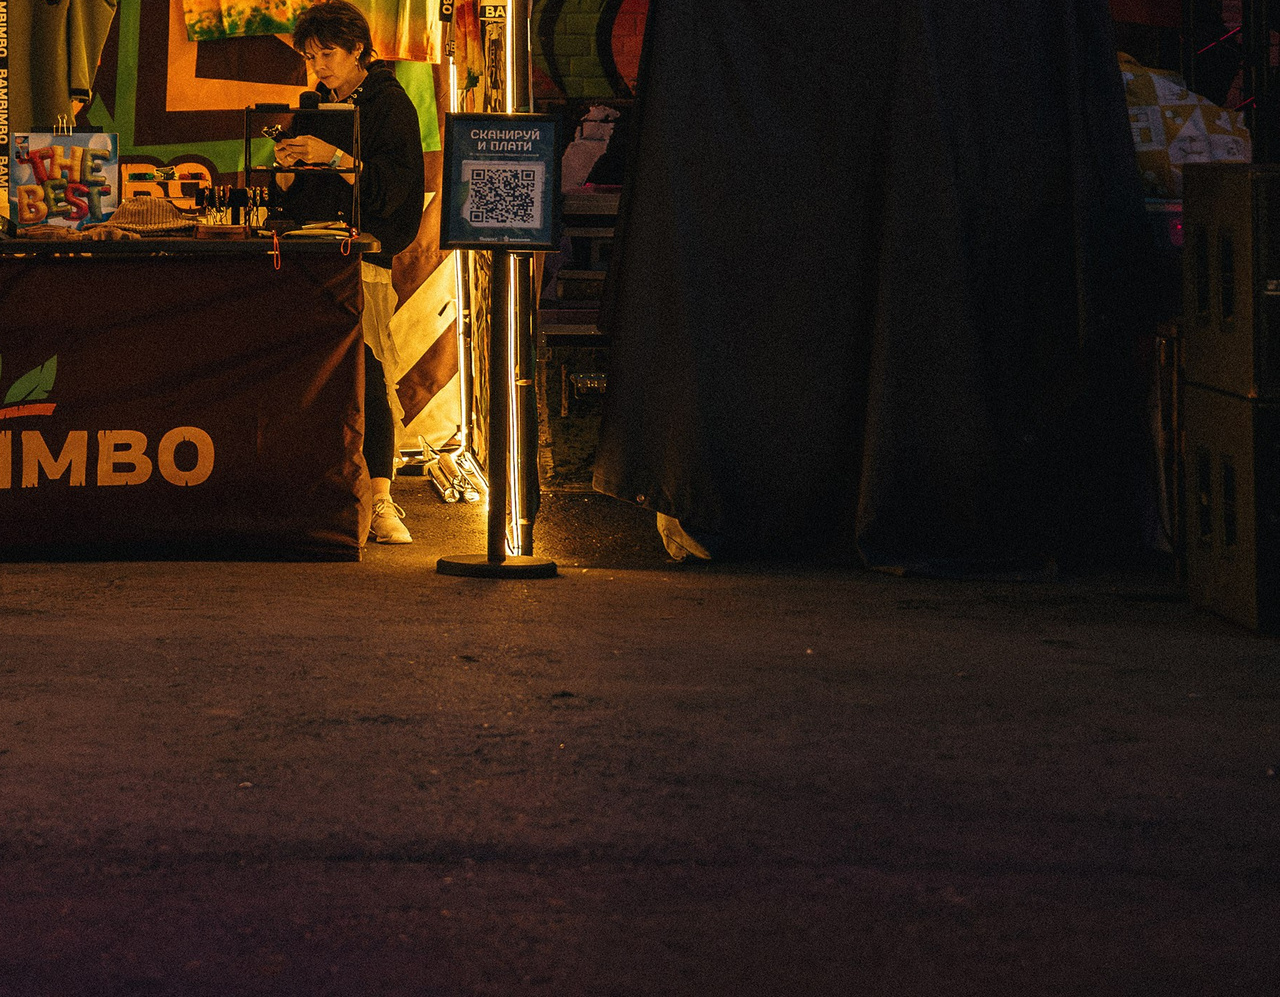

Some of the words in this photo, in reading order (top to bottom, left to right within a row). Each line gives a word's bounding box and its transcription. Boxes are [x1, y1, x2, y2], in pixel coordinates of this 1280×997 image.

[470, 129, 540, 140] СКАНИРУЙ
[478, 142, 486, 151] И
[490, 141, 532, 151] ПЛАТИ
[19, 145, 111, 185] THE
[16, 178, 111, 224] BEST
